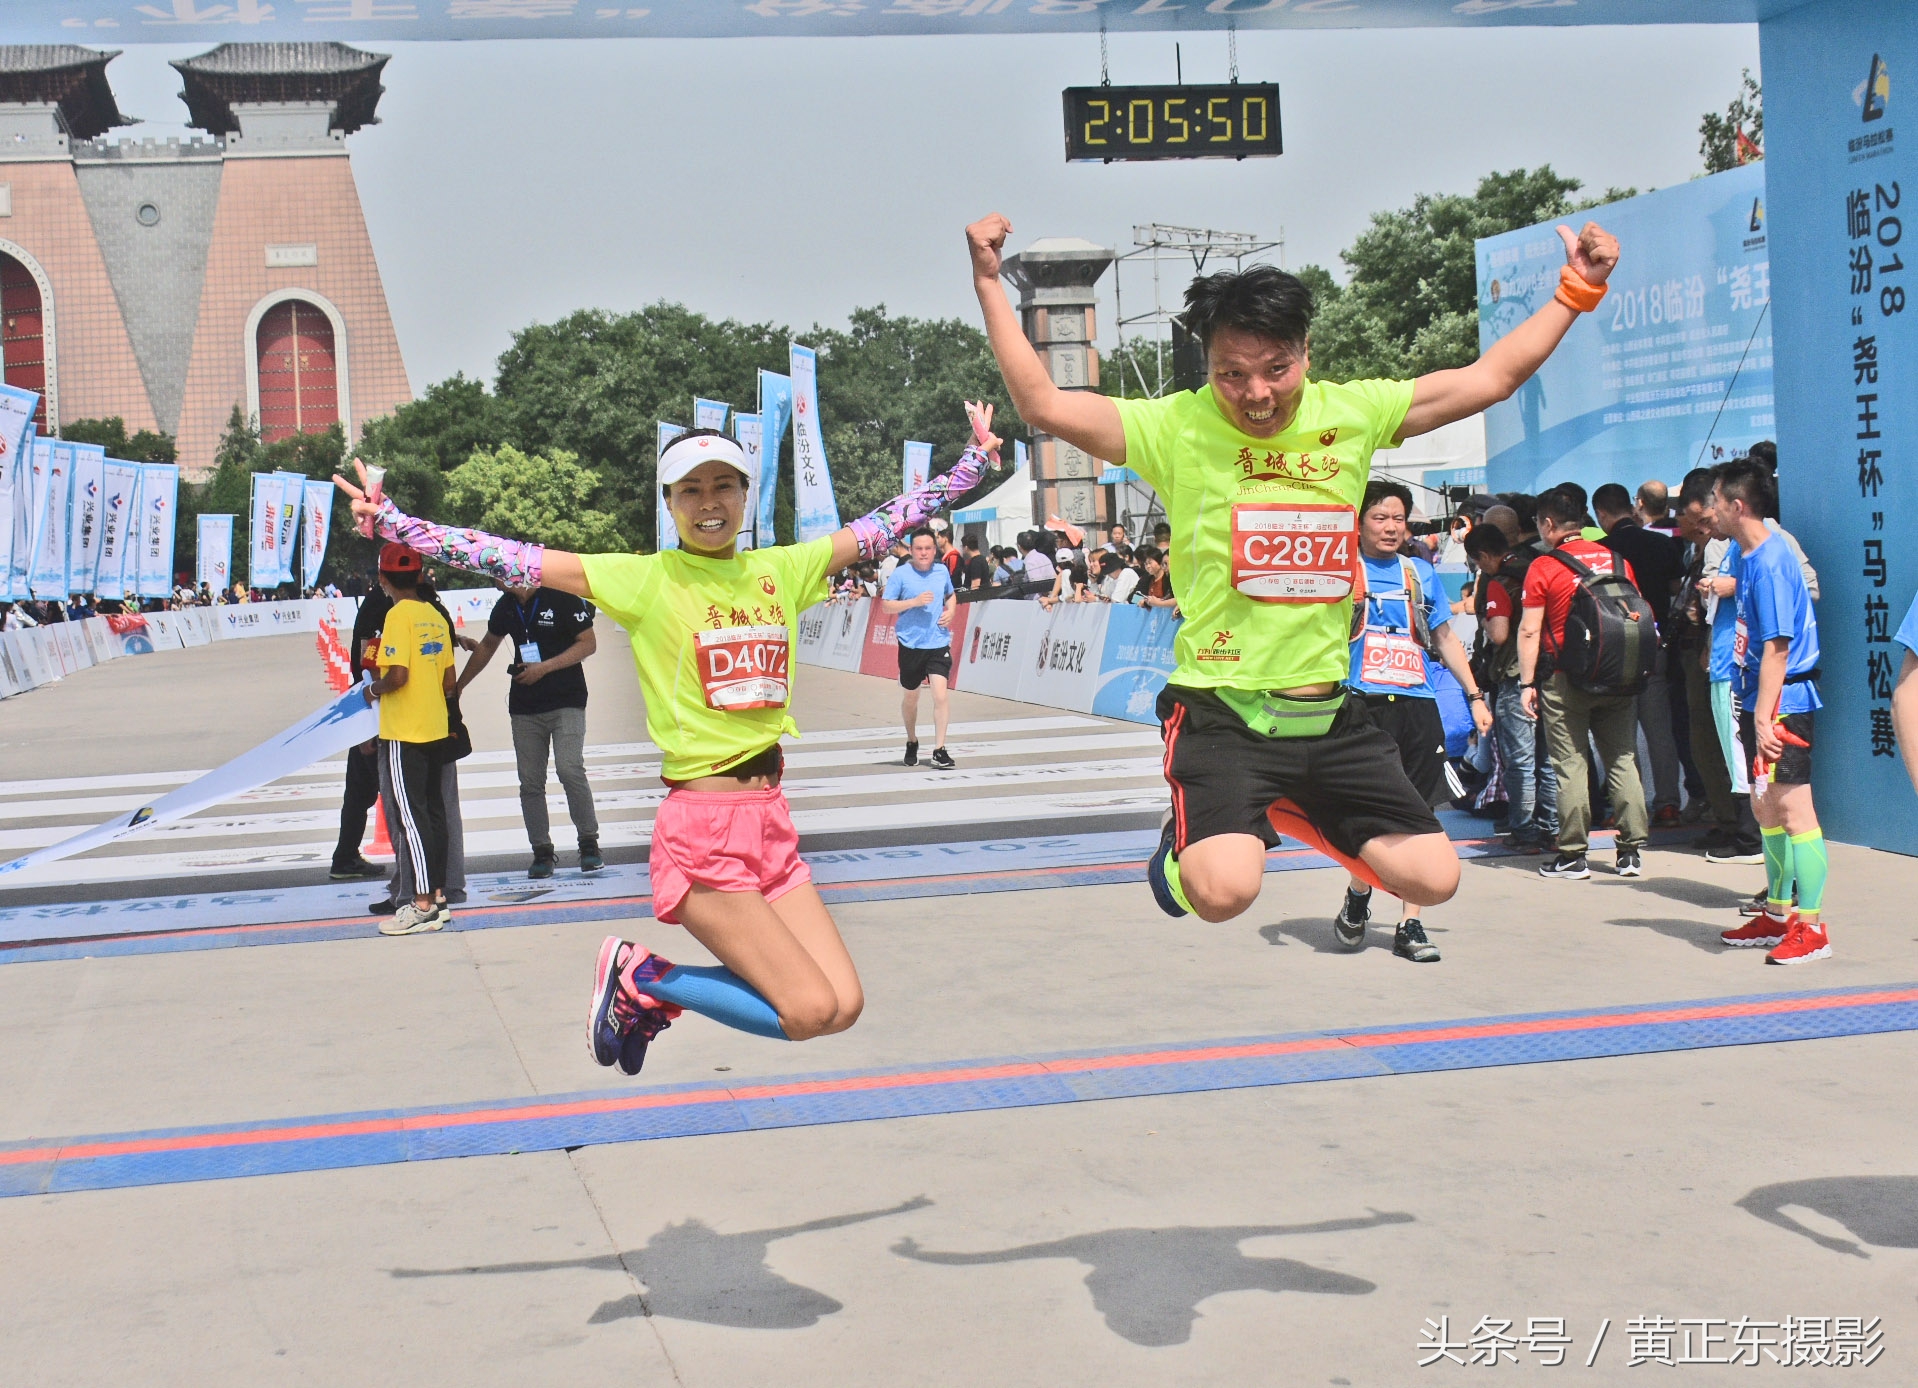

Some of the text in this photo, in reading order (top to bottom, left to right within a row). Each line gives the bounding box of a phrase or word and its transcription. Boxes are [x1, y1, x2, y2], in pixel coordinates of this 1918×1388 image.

[1085, 97, 1267, 144] 2:05:50
[1875, 181, 1905, 317] 2018
[796, 421, 818, 488] 临汾文化
[82, 501, 95, 549] 兴业集团
[104, 512, 118, 558] 兴业集团
[150, 514, 161, 558] 兴业集团
[1243, 535, 1349, 567] C2874
[981, 632, 1011, 662] 临汾体育
[1050, 639, 1085, 673] 临汾文化
[1369, 649, 1420, 670] C4010
